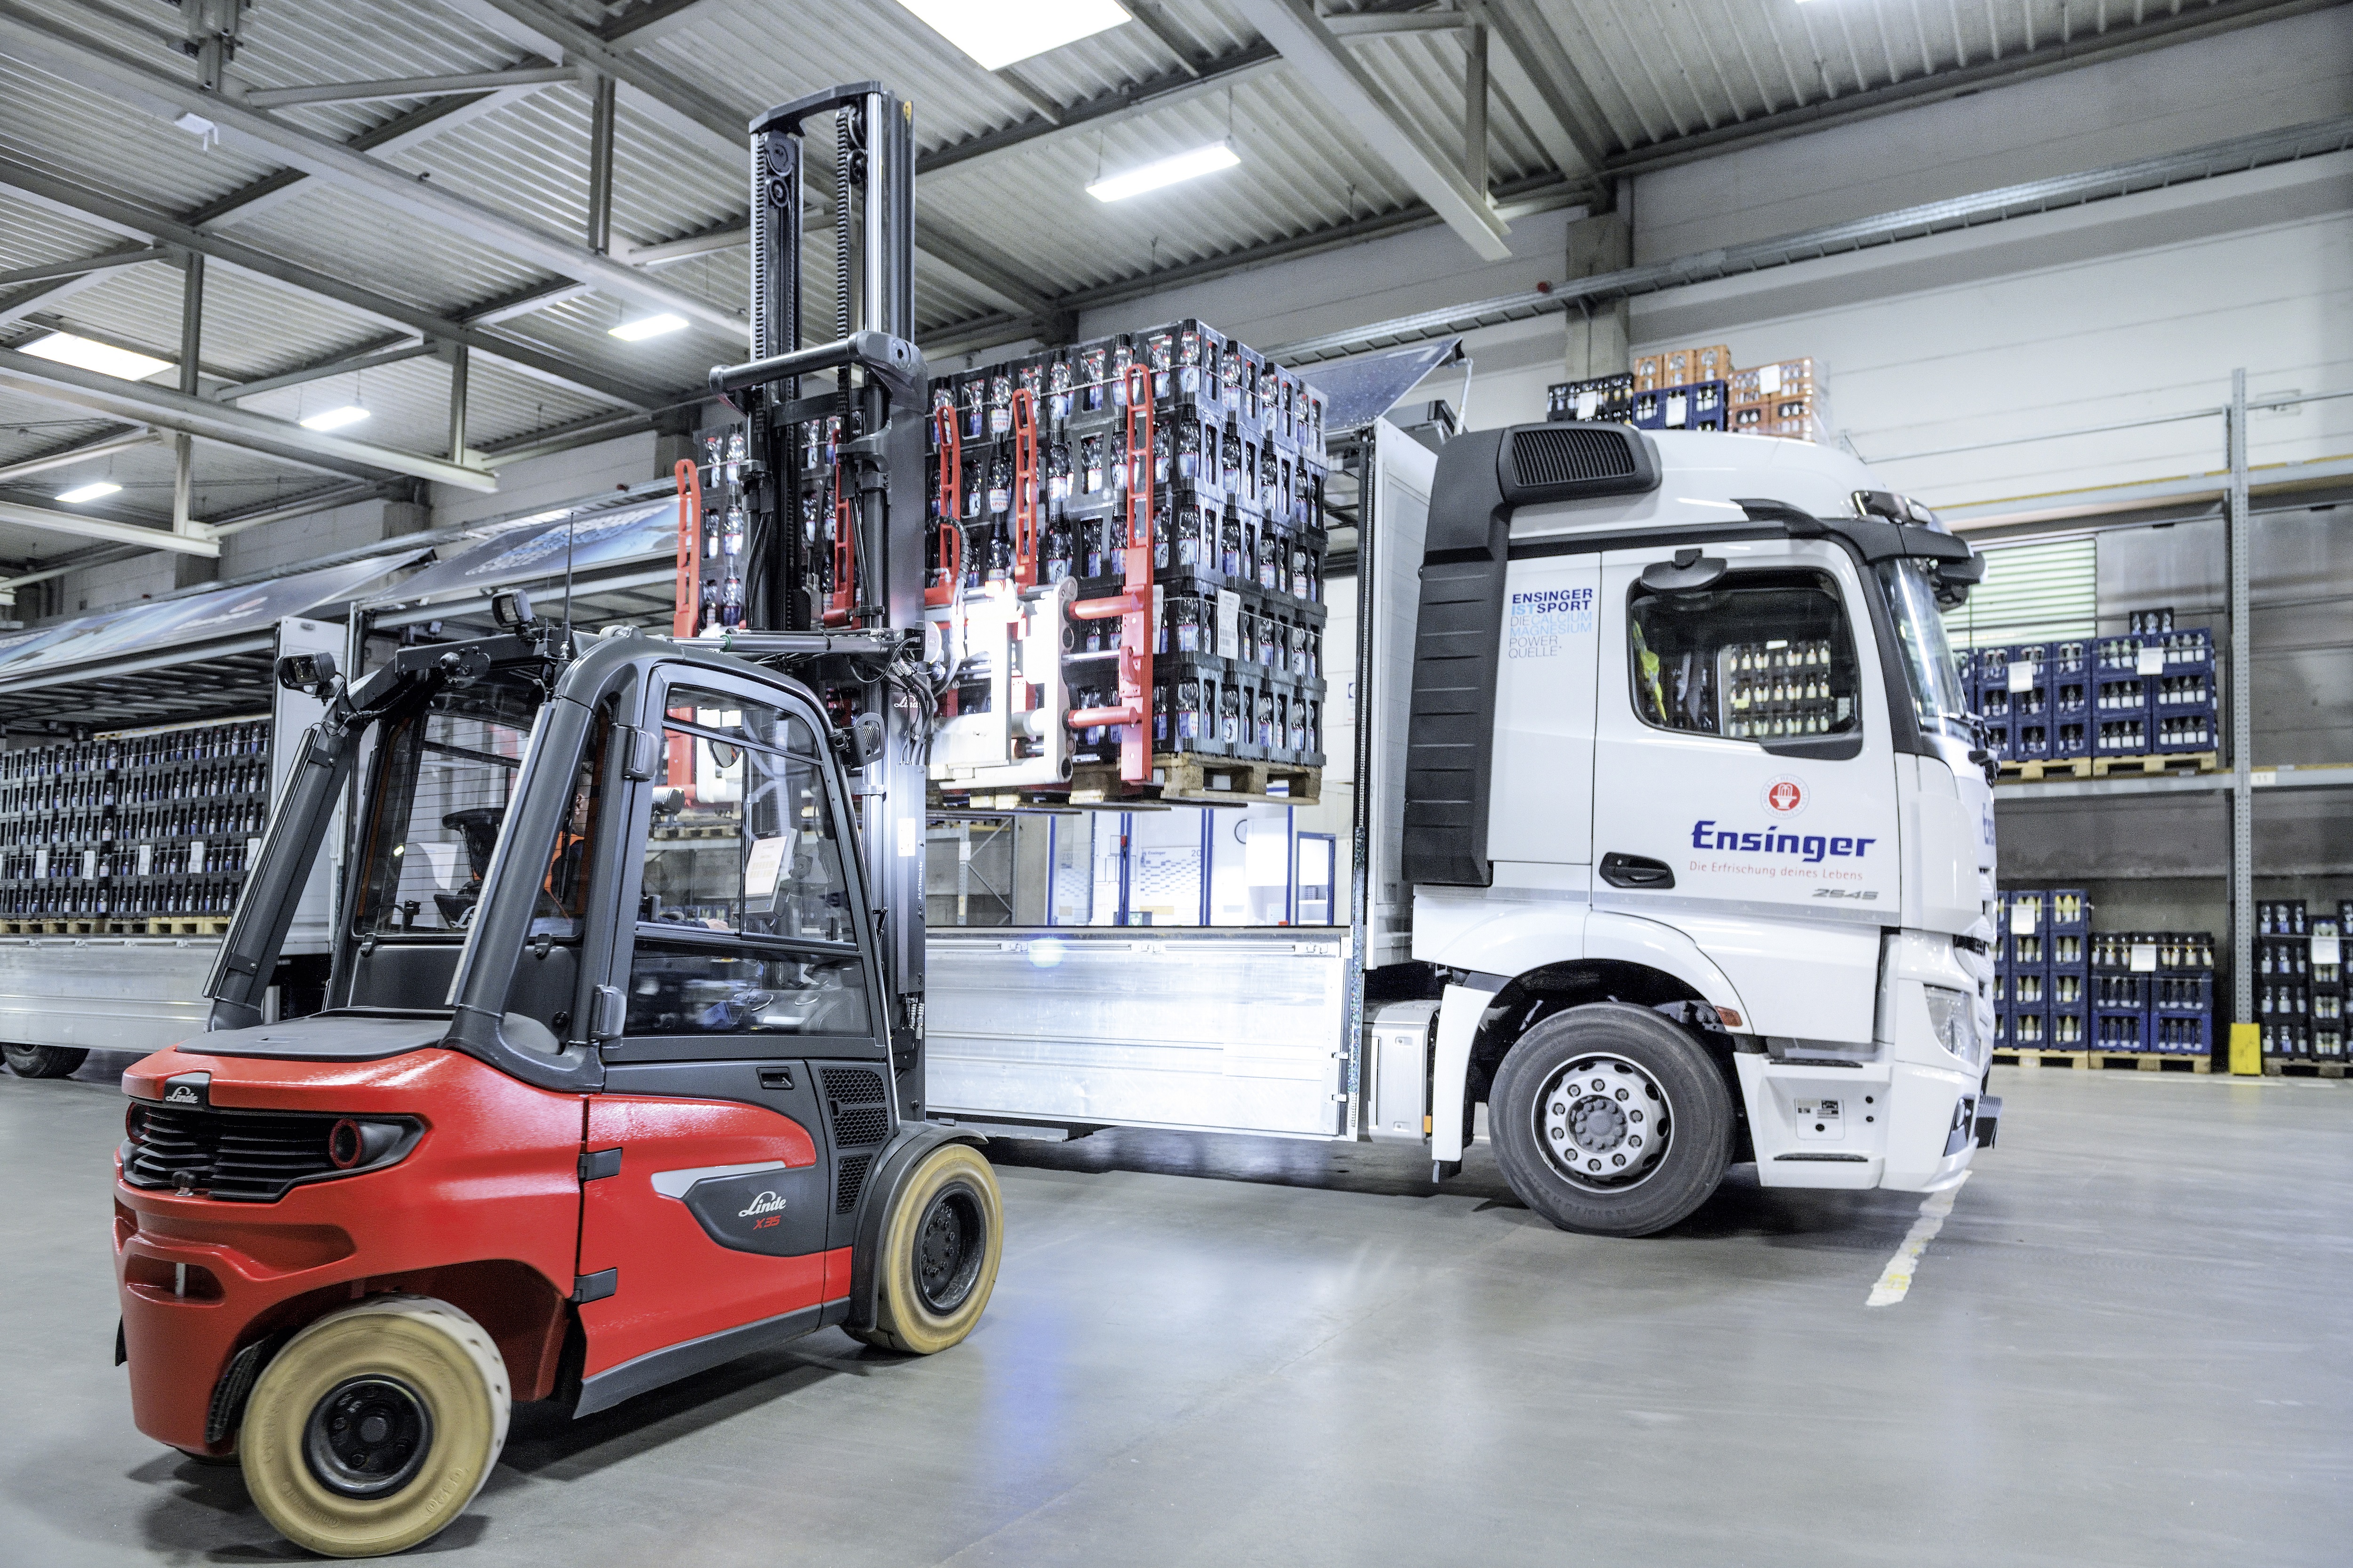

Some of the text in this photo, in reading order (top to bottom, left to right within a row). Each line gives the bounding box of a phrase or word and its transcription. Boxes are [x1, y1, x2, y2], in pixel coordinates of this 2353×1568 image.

[1512, 588, 1593, 604] ENSINGER
[1510, 623, 1592, 637] MAGNESIUM
[1509, 635, 1558, 648] POWER
[894, 695, 918, 708] Lind
[1691, 820, 1877, 863] Ensinger
[1689, 861, 1863, 880] Die Erfrischung deines Lebens
[165, 1086, 198, 1104] Linde
[738, 1191, 786, 1217] Linde
[753, 1215, 781, 1230] X35
